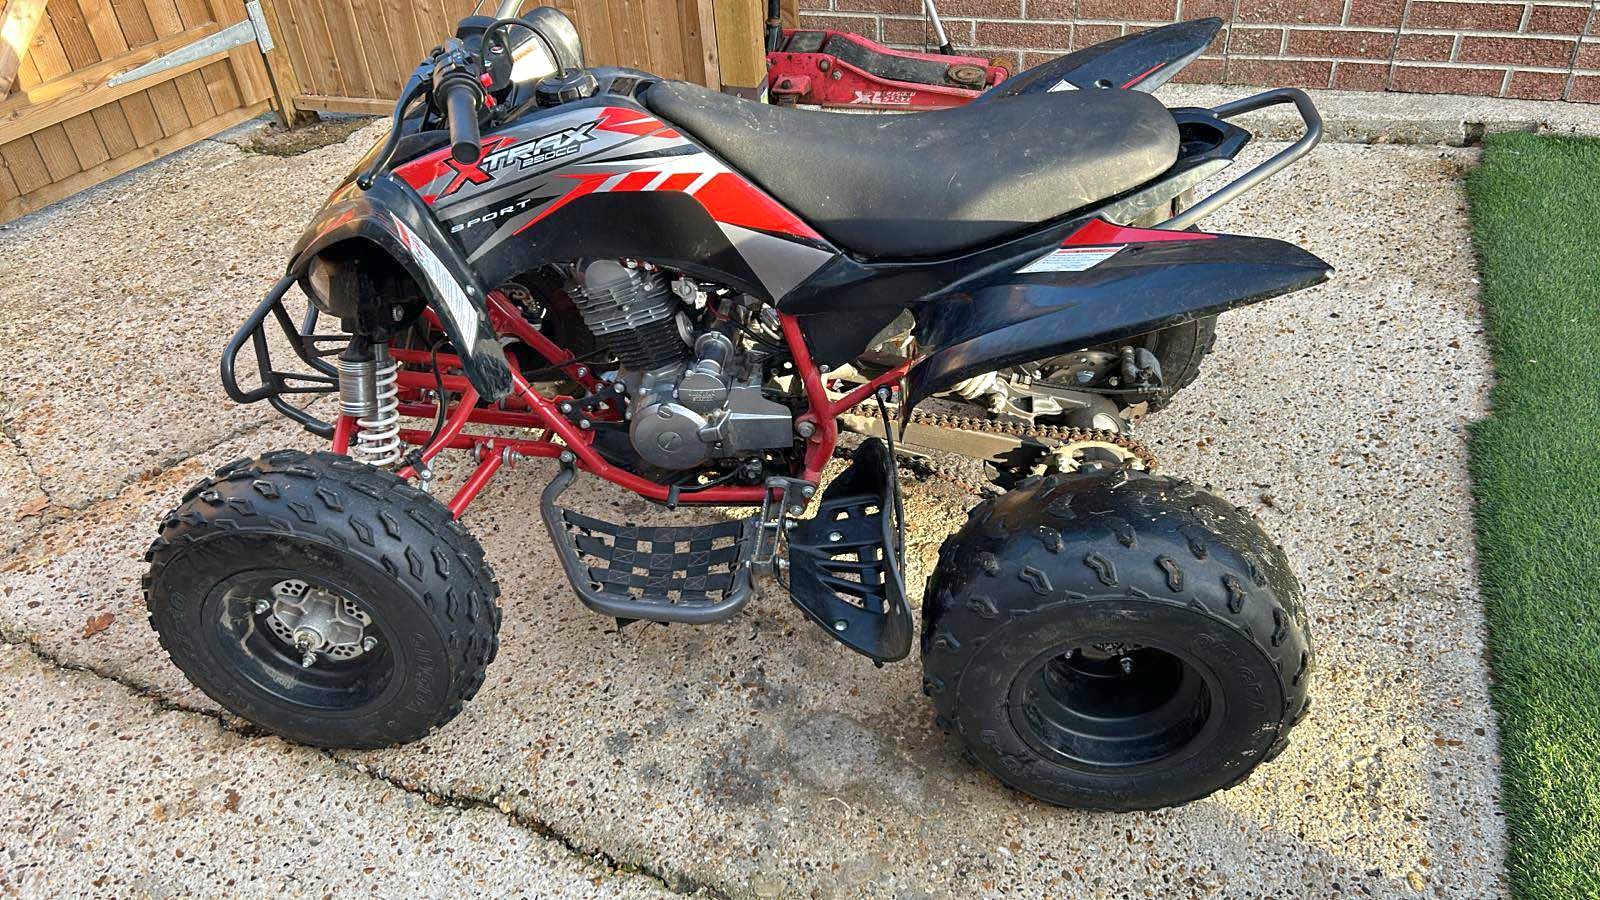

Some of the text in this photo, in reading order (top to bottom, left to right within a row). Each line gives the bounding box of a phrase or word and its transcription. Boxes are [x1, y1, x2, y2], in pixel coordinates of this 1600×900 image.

[437, 117, 604, 201] XTRAX
[521, 144, 581, 167] 250CC
[450, 198, 531, 234] SPORT
